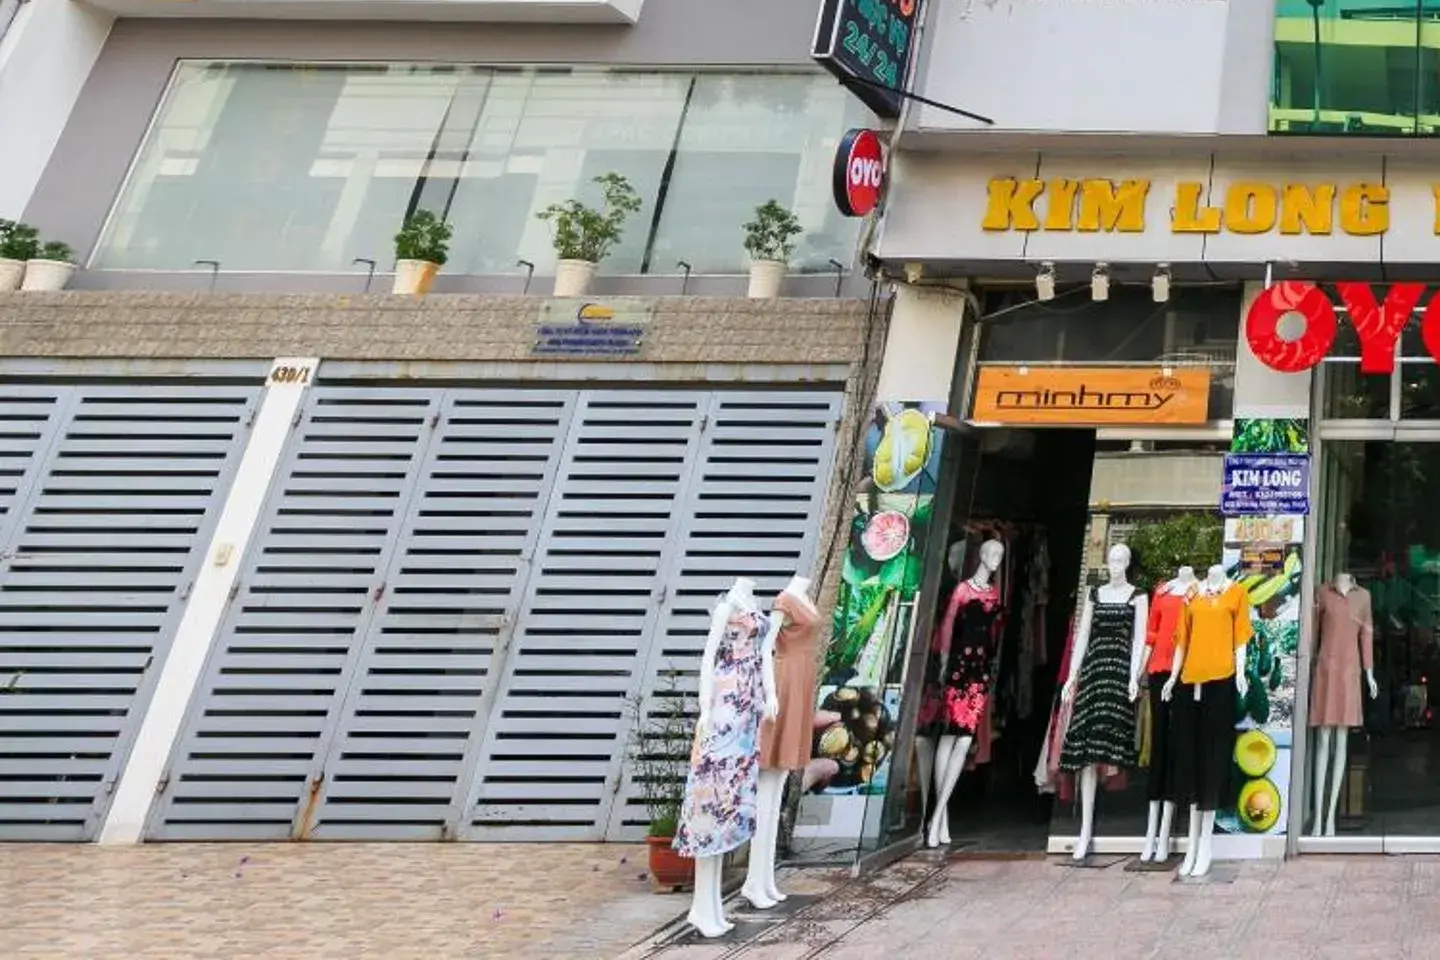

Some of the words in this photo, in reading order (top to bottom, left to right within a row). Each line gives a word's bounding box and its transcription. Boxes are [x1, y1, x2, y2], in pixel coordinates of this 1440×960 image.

[851, 156, 882, 187] OYO
[981, 176, 1151, 234] KIM
[1170, 180, 1392, 237] LONG
[996, 383, 1175, 410] minhmy
[1232, 469, 1260, 486] KIM
[1263, 469, 1302, 486] LONG
